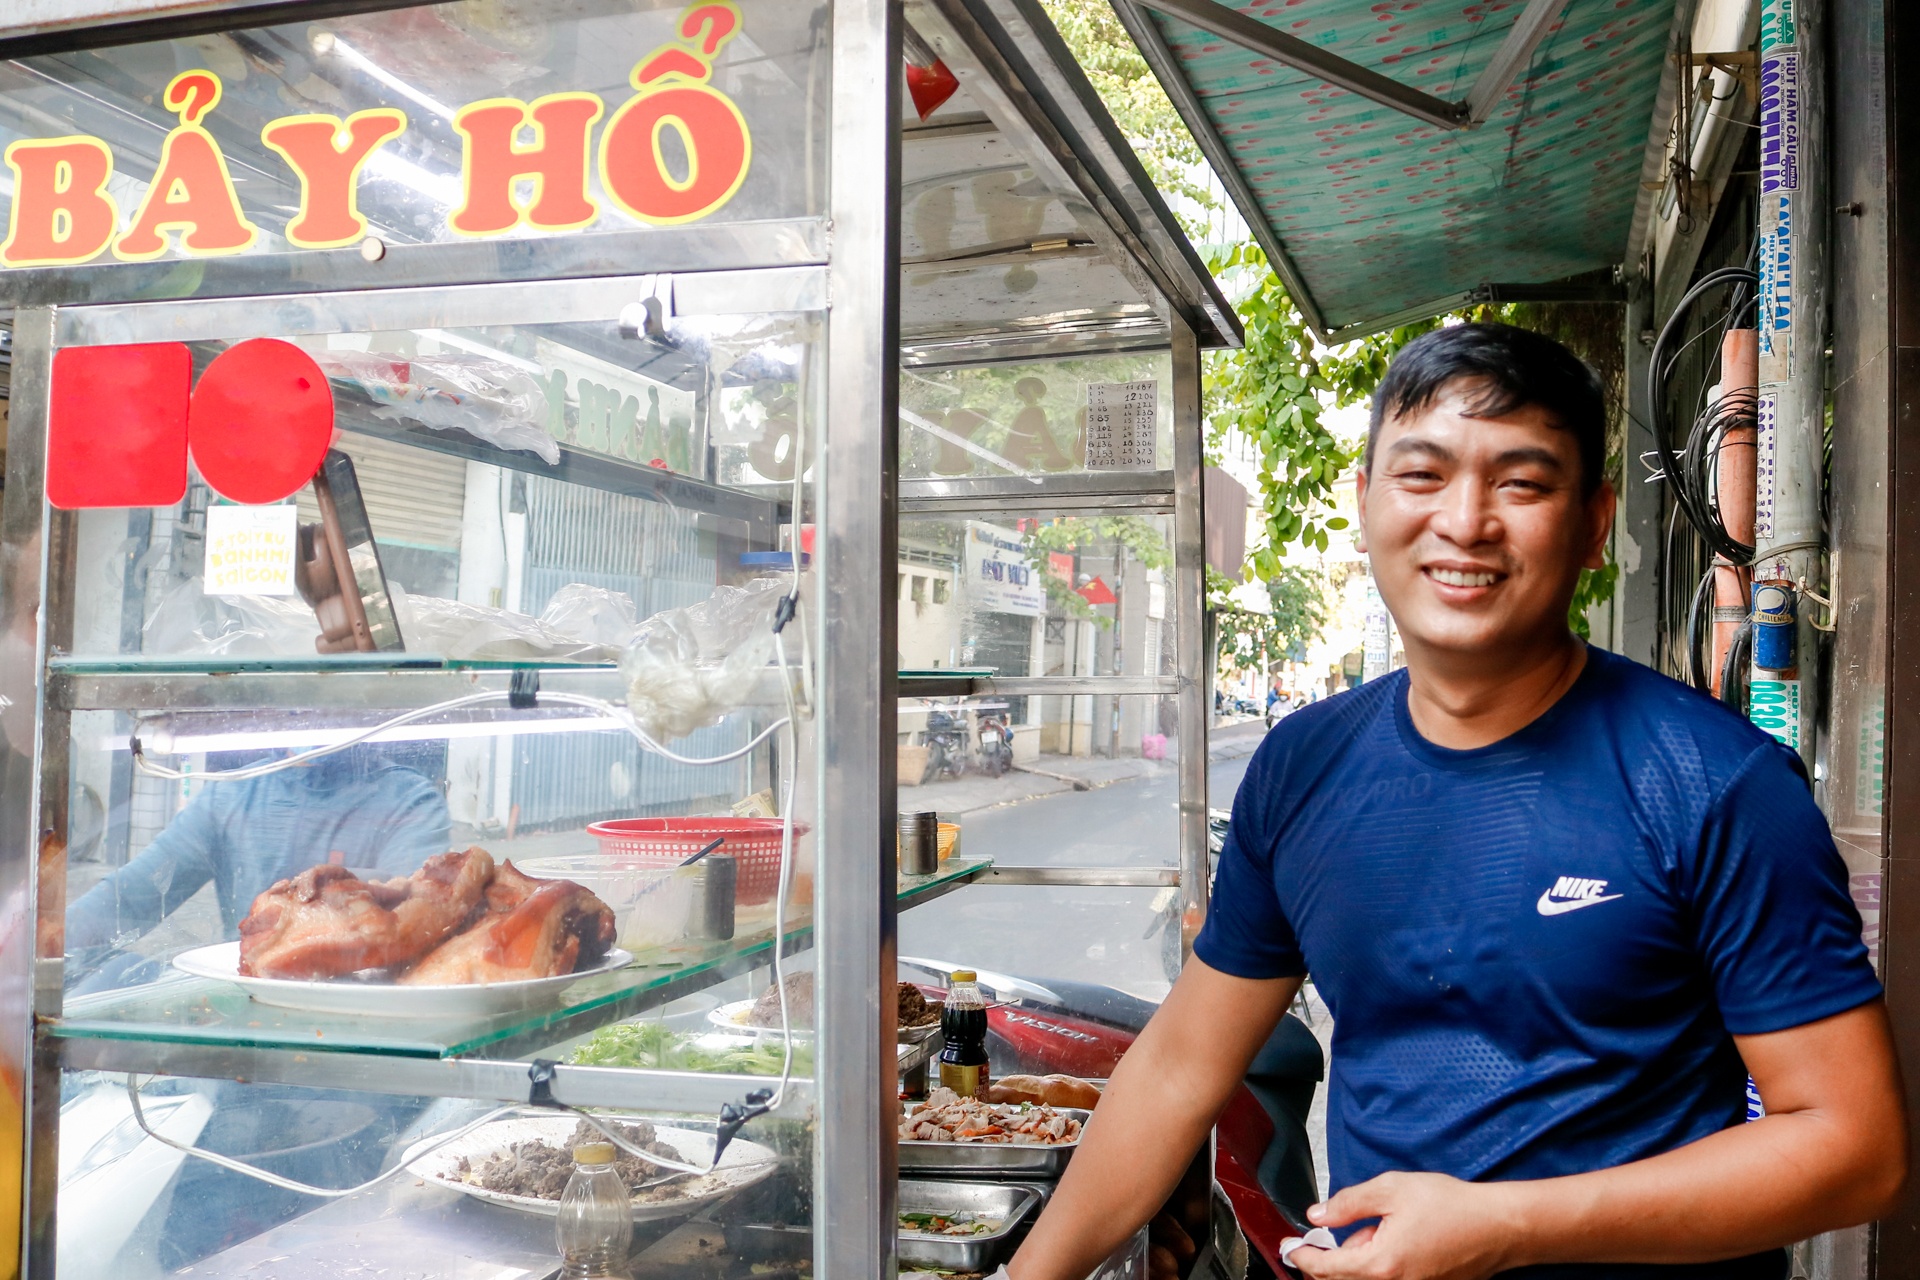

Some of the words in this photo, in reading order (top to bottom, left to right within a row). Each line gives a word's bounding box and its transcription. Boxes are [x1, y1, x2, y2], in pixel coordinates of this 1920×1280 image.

[0, 69, 408, 268] BẢY
[449, 0, 752, 237] HỔ
[1125, 392, 1137, 401] 12
[1550, 876, 1608, 899] NIKE
[1004, 1010, 1100, 1044] VISION
